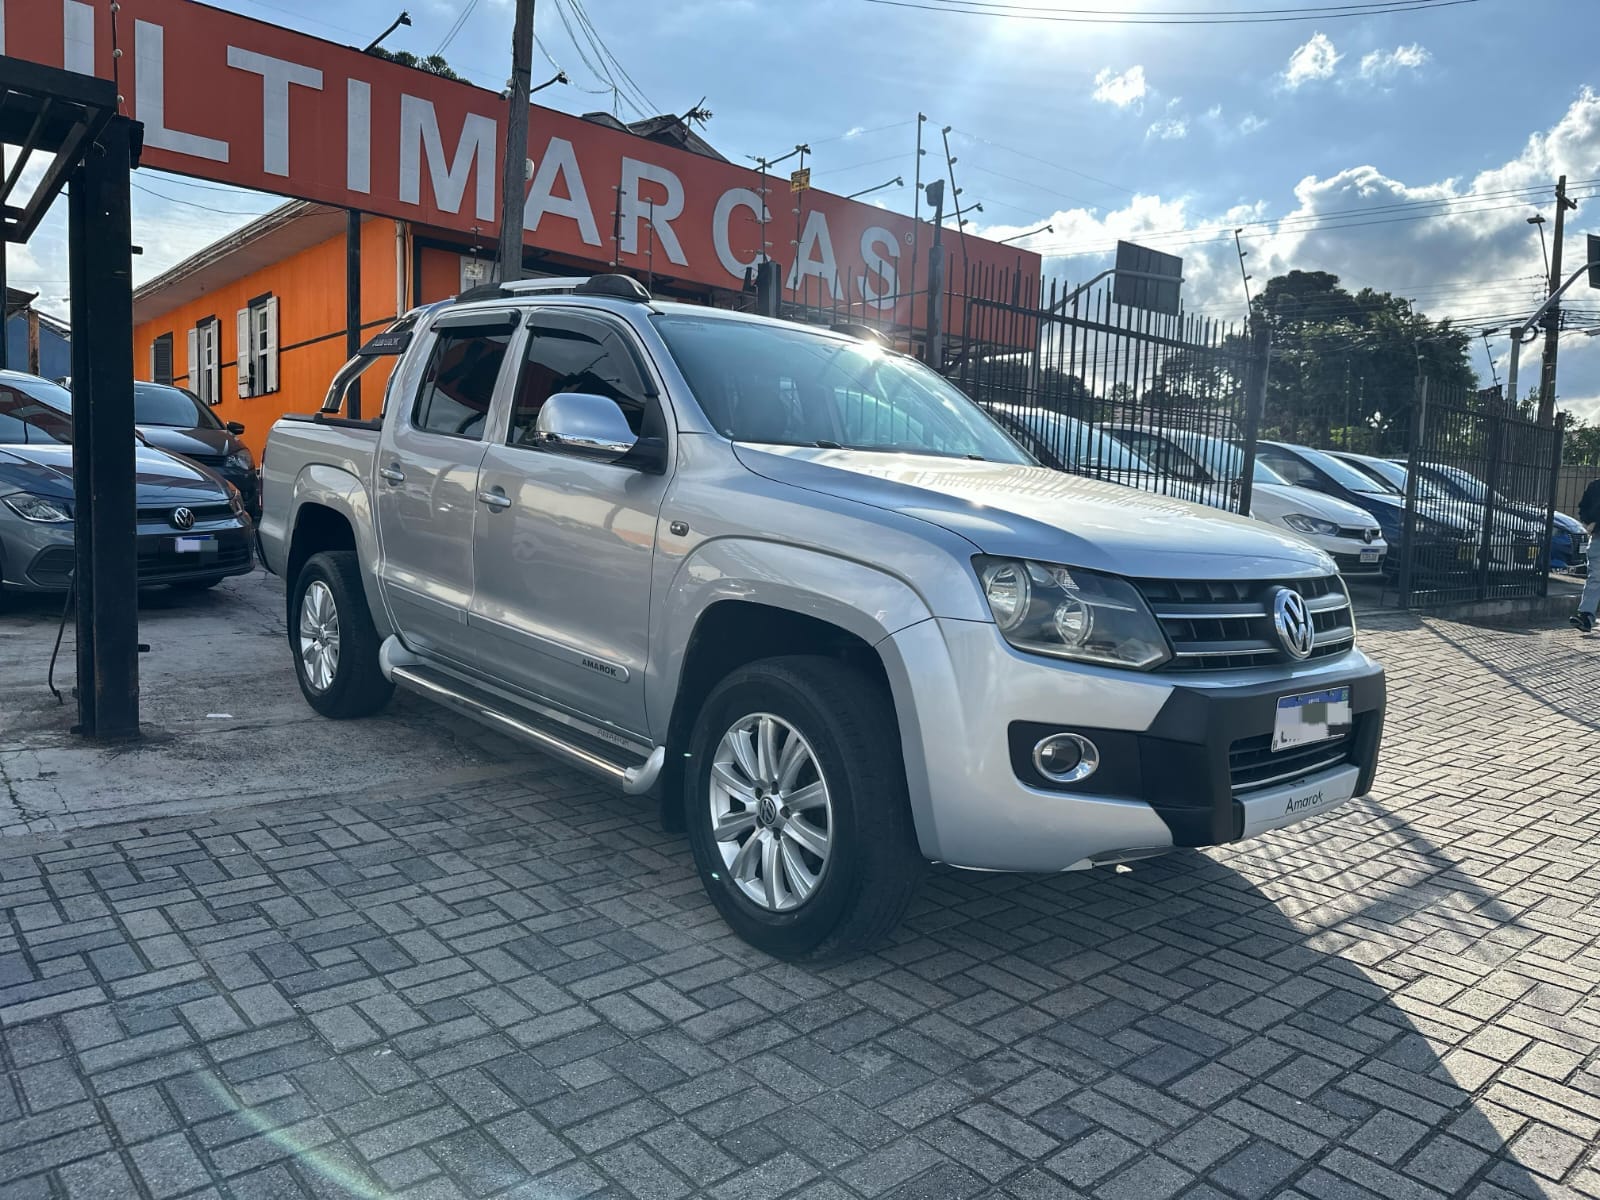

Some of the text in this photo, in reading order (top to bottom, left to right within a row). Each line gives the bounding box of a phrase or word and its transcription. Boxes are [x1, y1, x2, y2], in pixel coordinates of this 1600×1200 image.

[1274, 588, 1314, 660] VW
[582, 658, 617, 677] AMAROK
[1285, 790, 1324, 814] Amarok
